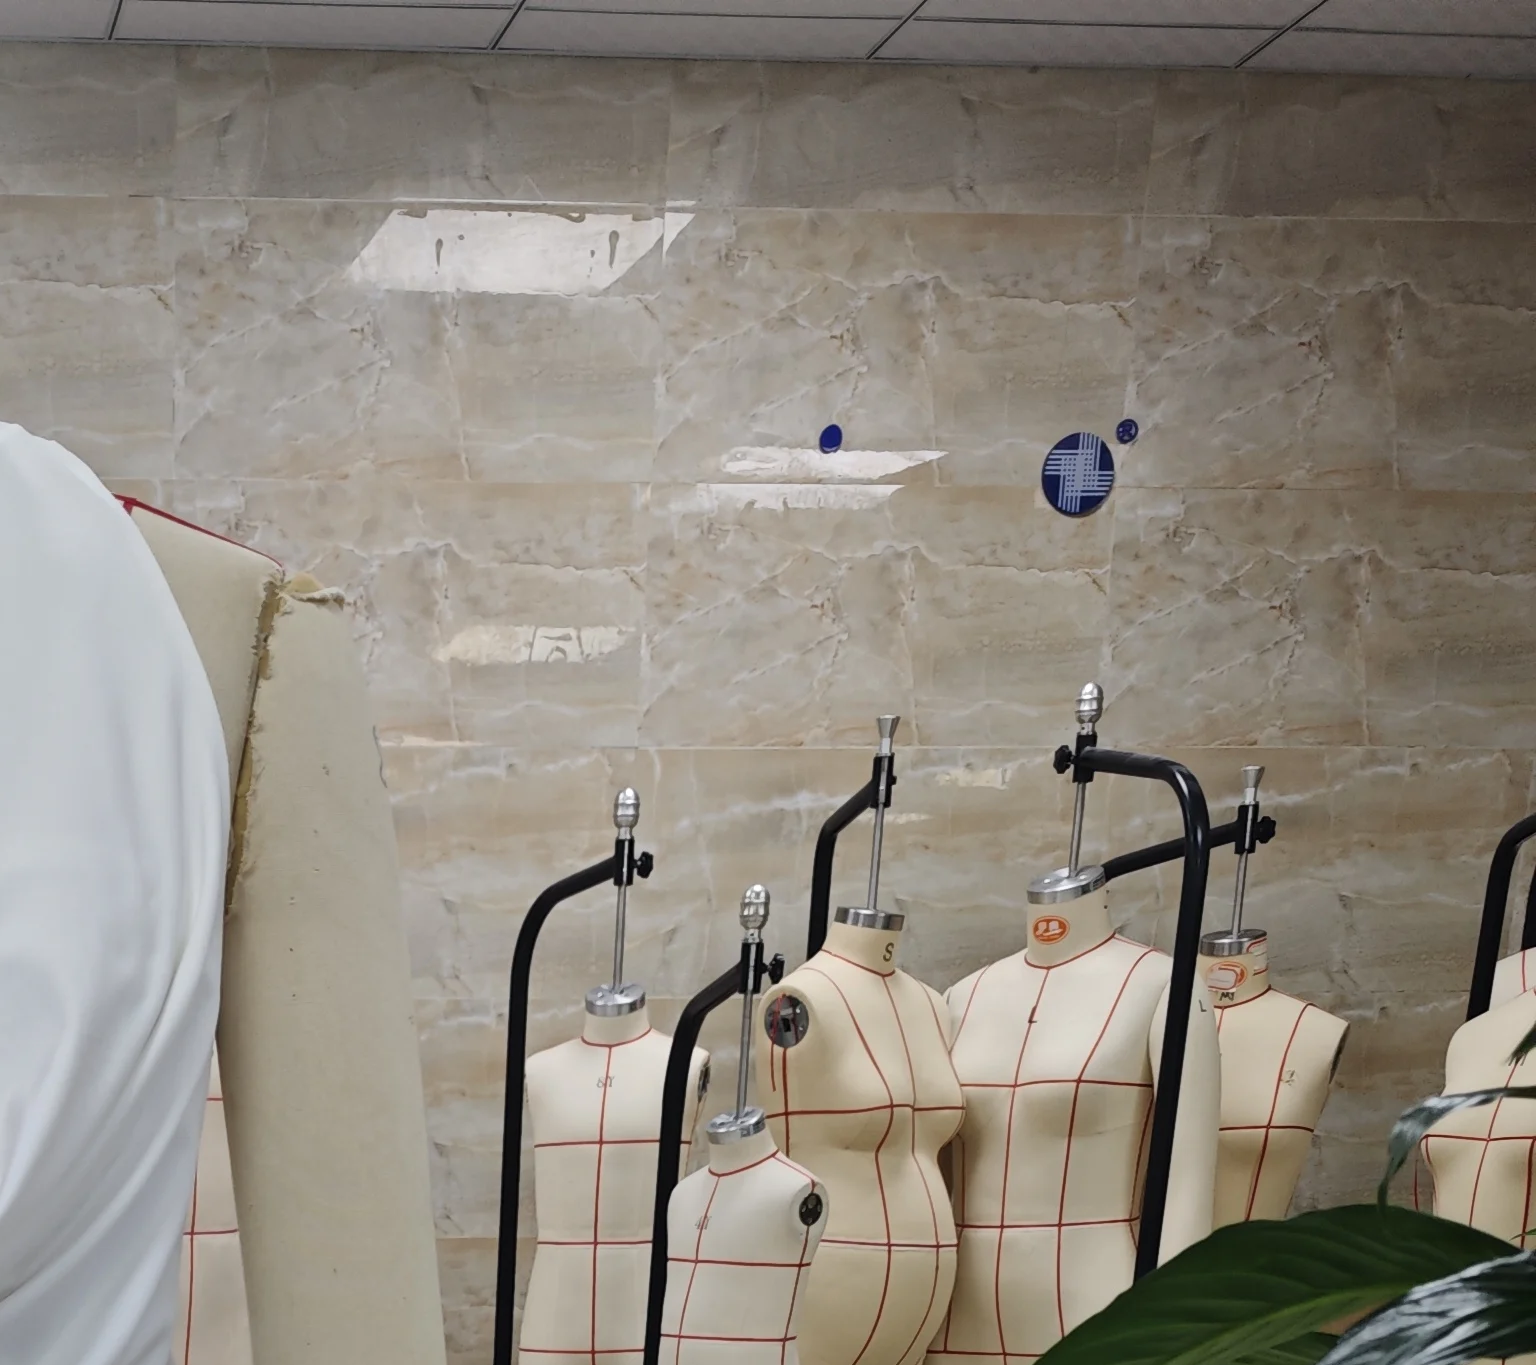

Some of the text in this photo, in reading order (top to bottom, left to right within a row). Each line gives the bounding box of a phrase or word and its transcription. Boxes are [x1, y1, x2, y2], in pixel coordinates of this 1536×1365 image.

[883, 942, 894, 962] S
[1028, 1005, 1038, 1023] L
[1198, 999, 1207, 1012] L
